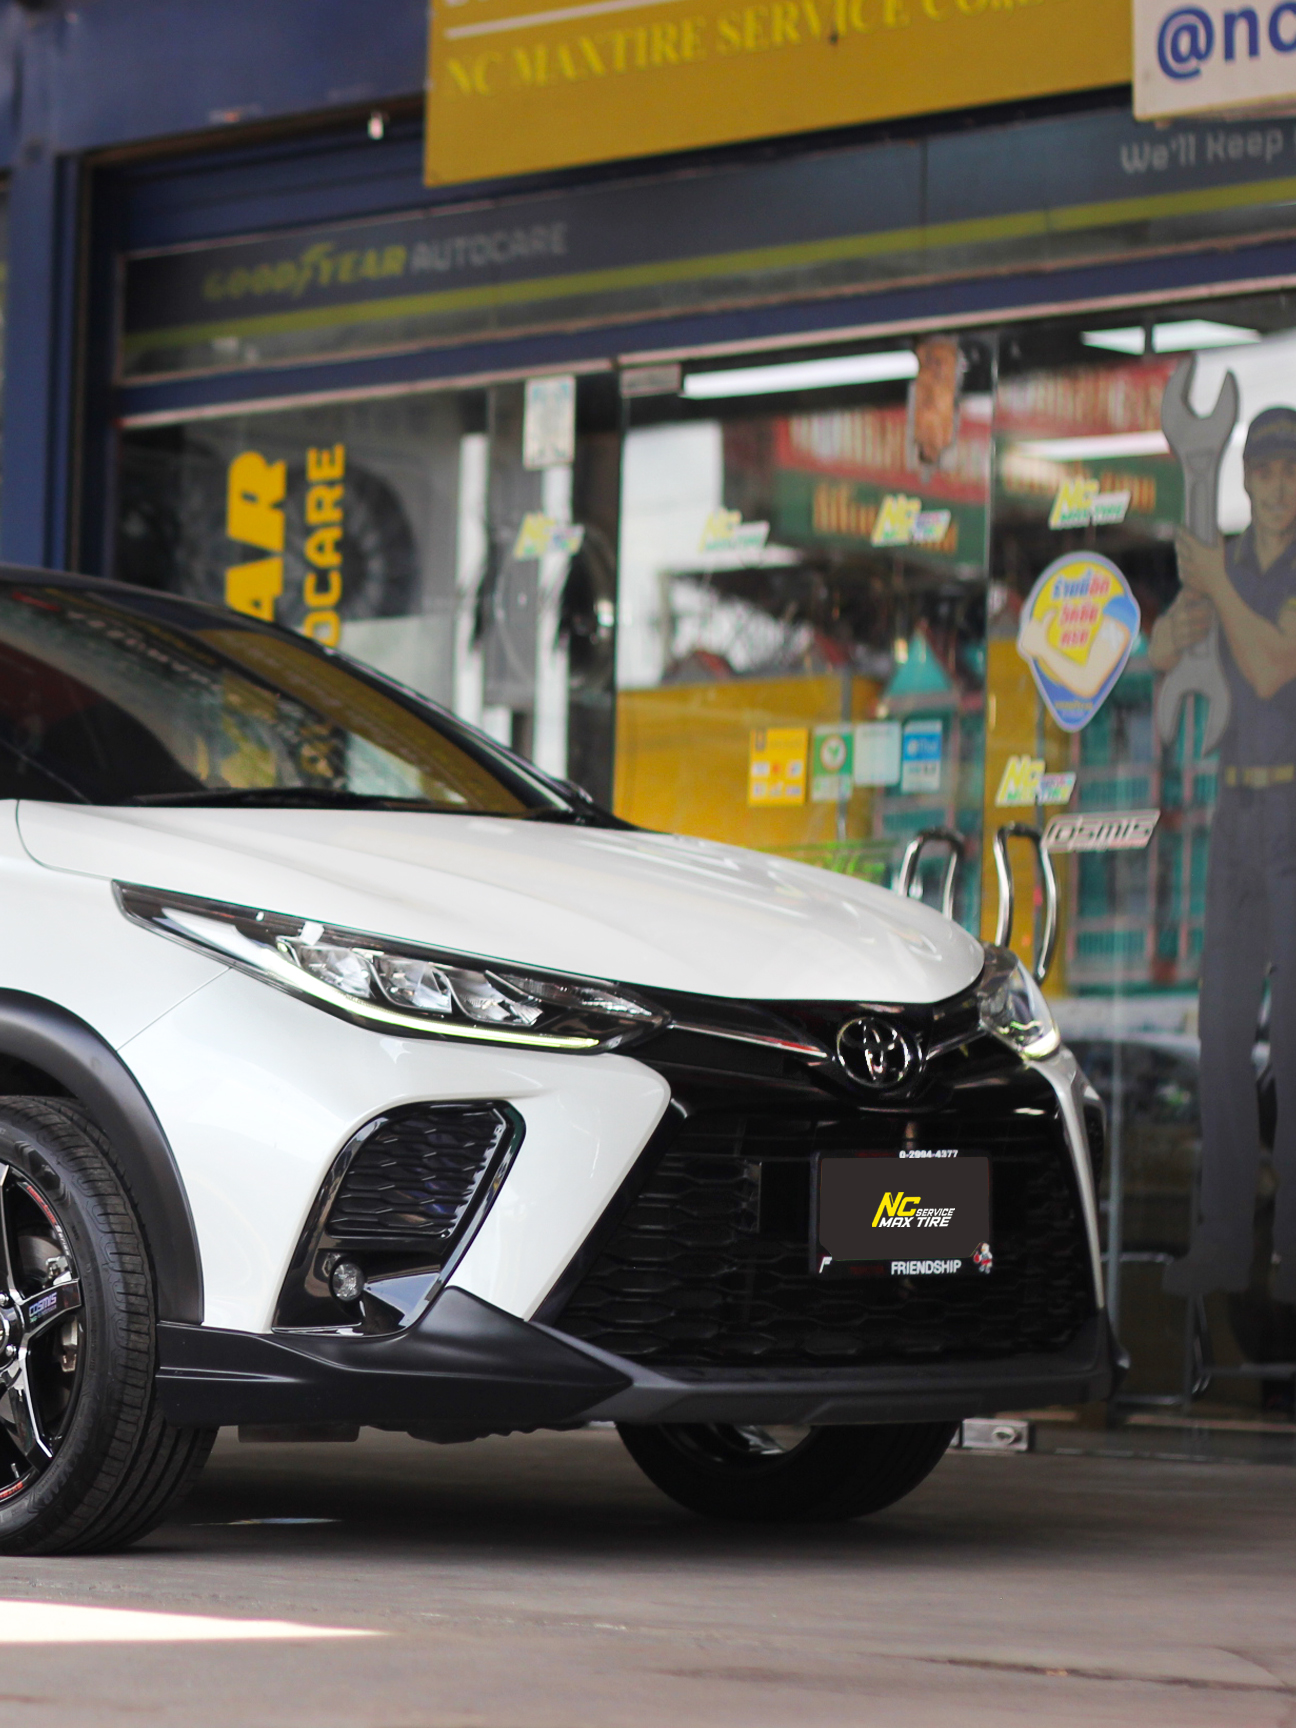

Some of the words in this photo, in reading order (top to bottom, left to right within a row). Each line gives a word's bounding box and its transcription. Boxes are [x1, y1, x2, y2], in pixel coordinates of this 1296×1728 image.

[716, 0, 911, 56] SERVICE
[410, 221, 567, 274] AUTOCARE
[891, 1260, 961, 1275] FRIENDSHIP
